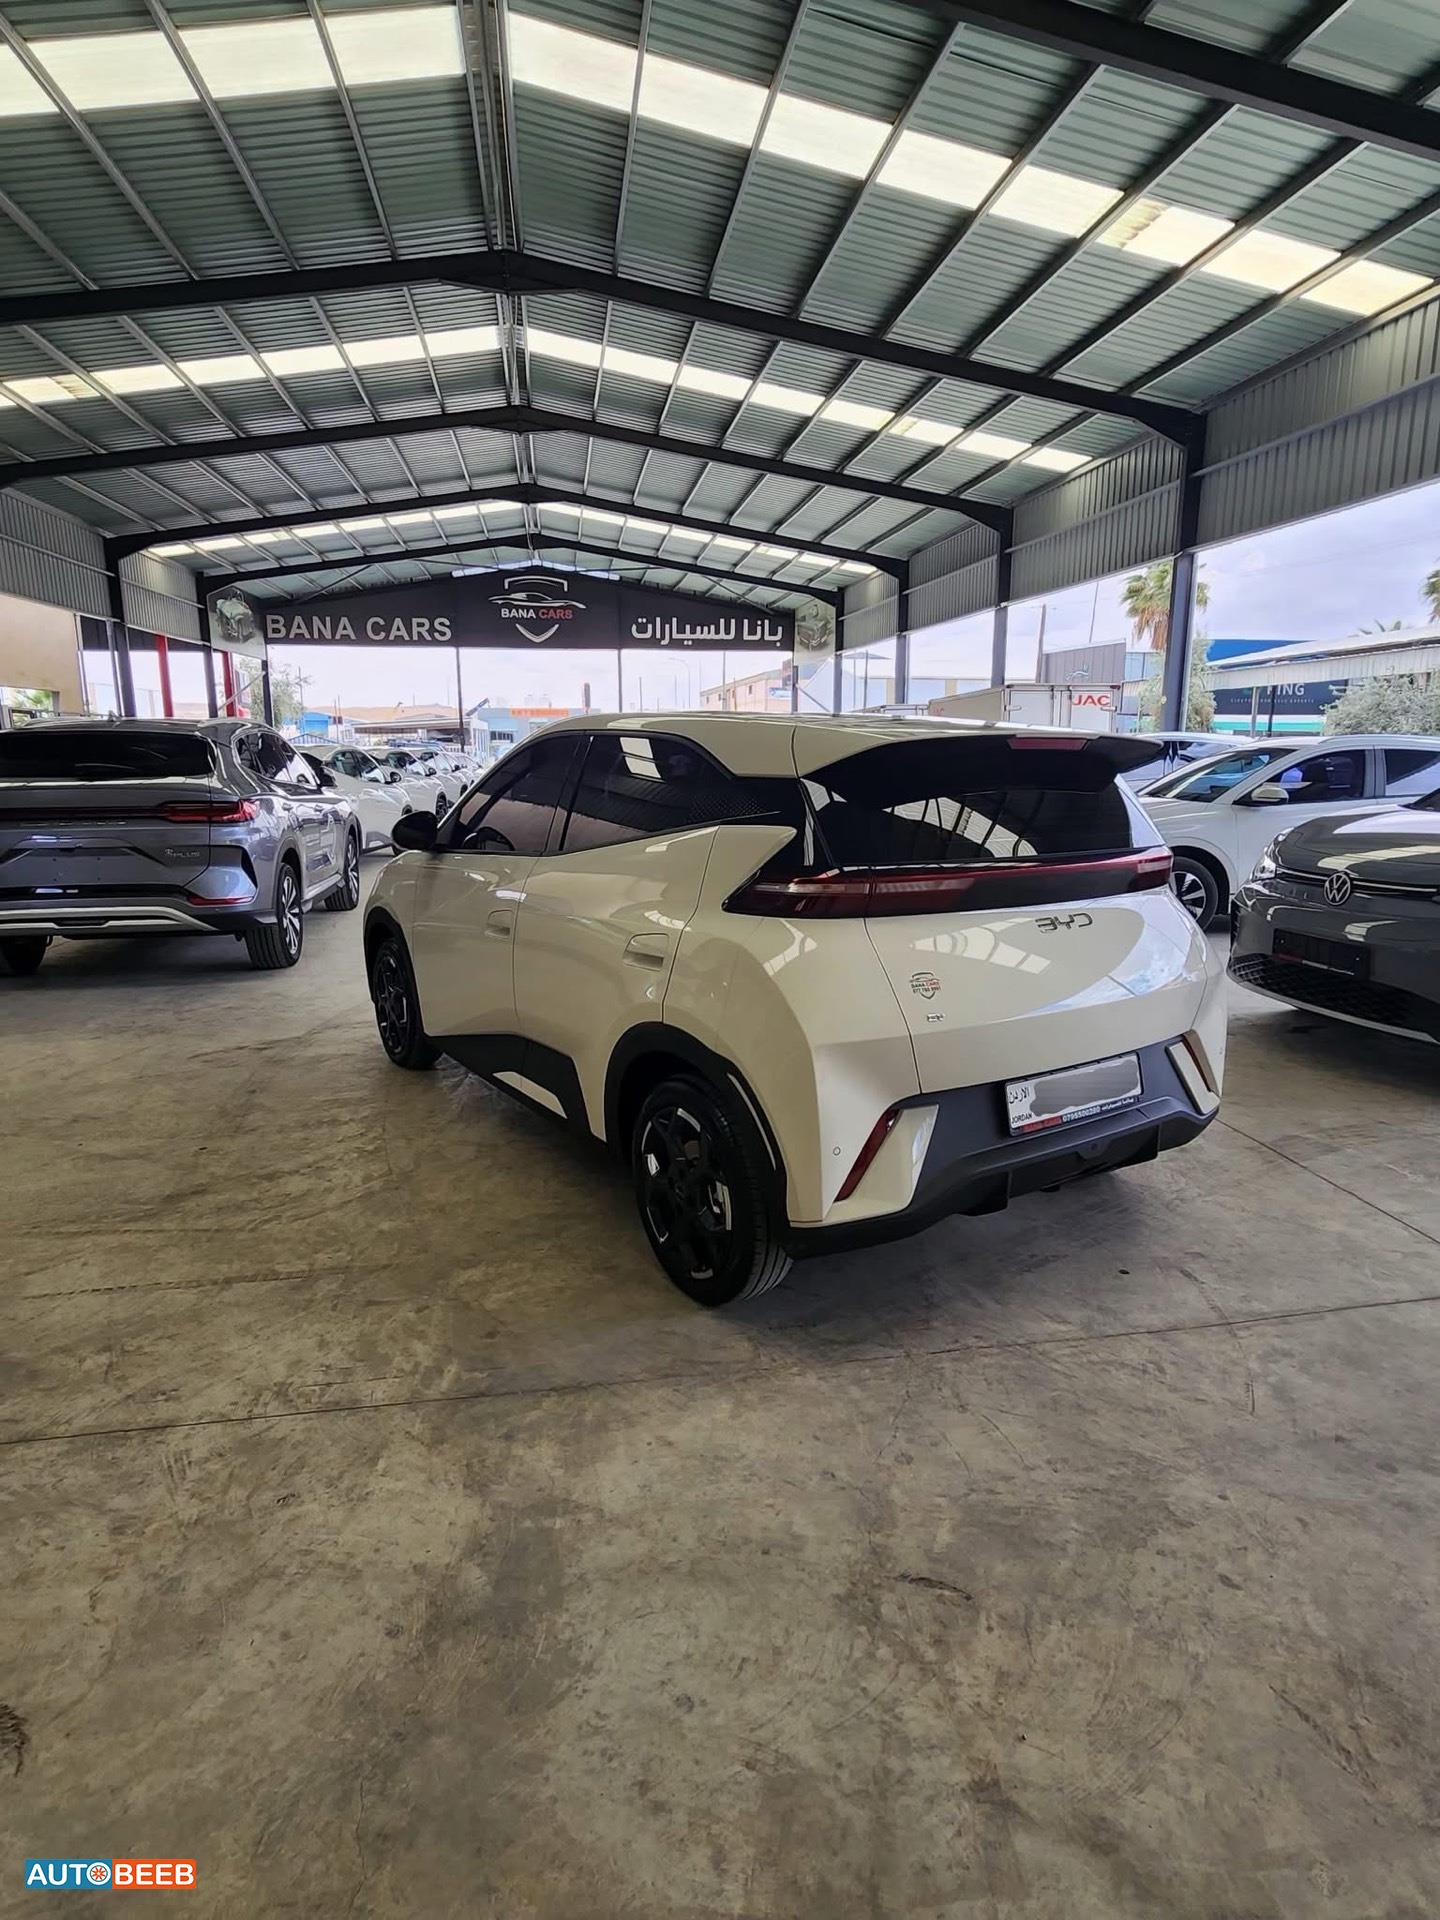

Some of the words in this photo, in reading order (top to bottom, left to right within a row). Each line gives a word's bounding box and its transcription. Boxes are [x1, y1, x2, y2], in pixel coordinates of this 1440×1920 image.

[501, 608, 536, 619] BANA
[538, 608, 573, 619] CARS
[265, 614, 356, 640] BANA
[366, 616, 452, 641] CARS
[631, 616, 736, 646] للسيارات
[742, 618, 783, 647] بانا
[1073, 695, 1110, 706] JAC
[1035, 912, 1093, 933] BYD
[1011, 1112, 1033, 1124] JORDAN
